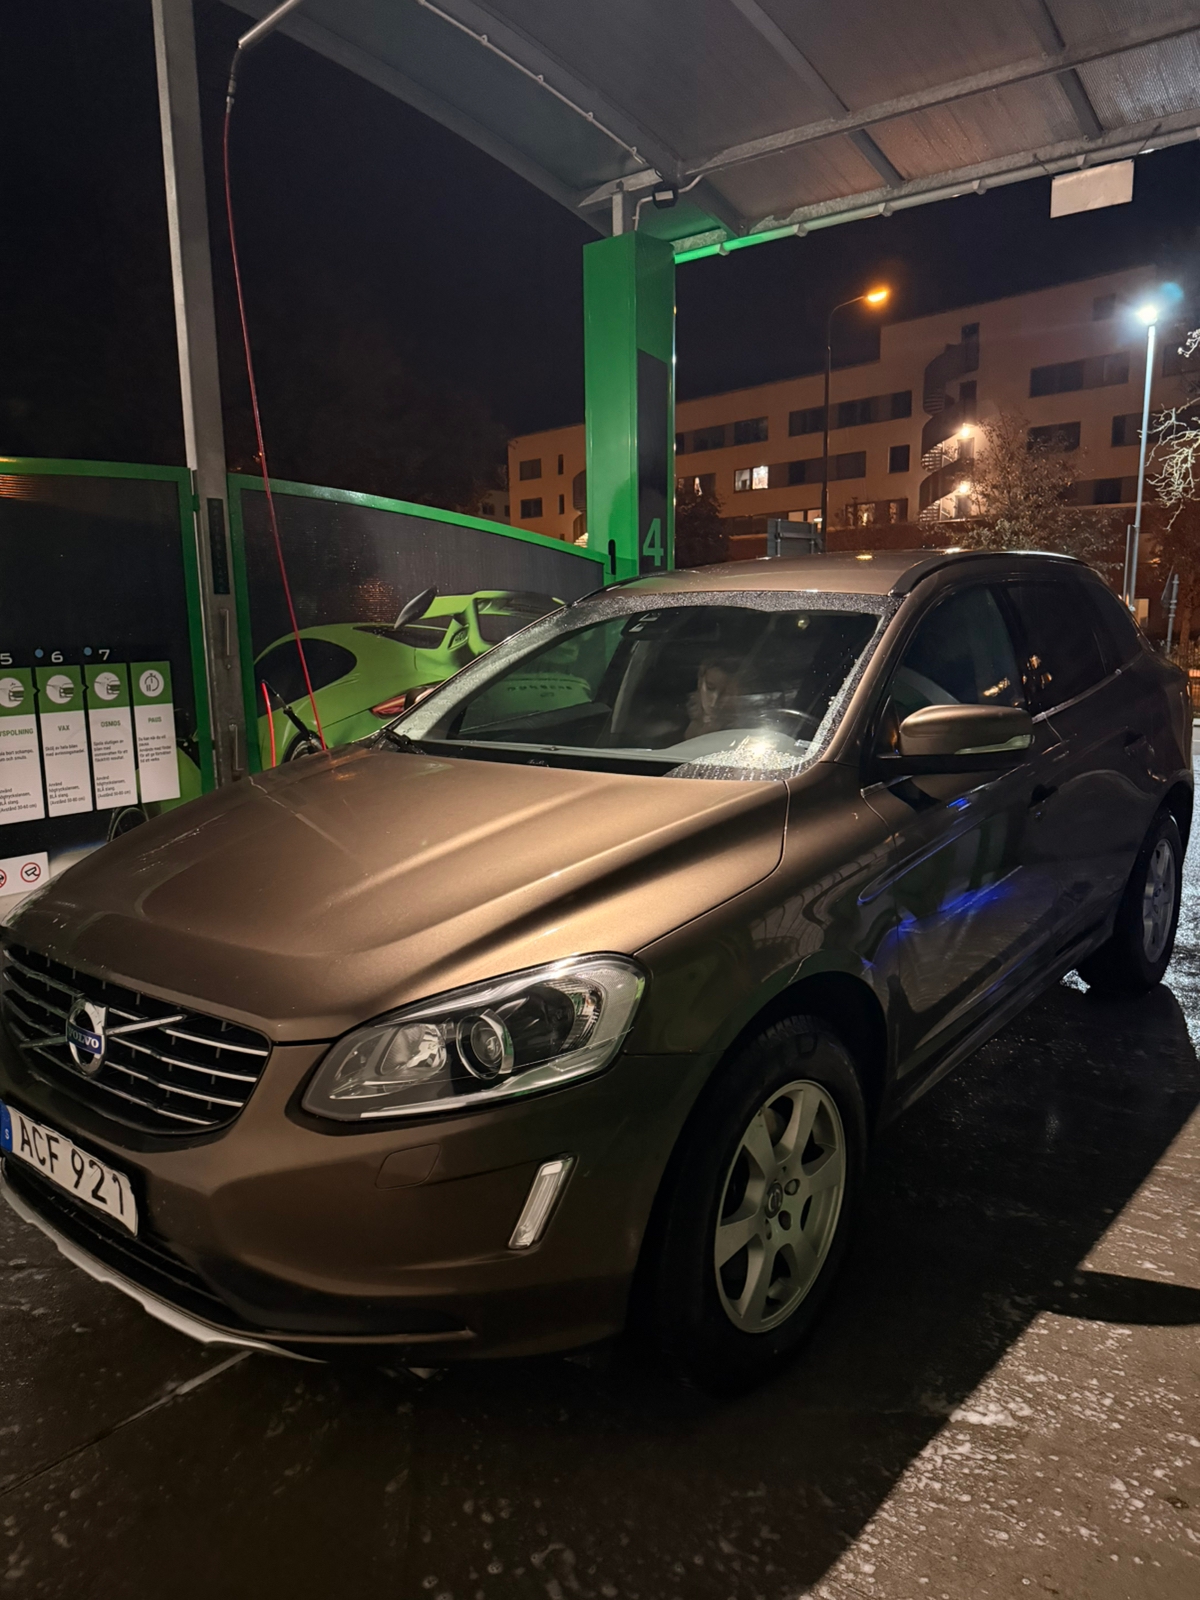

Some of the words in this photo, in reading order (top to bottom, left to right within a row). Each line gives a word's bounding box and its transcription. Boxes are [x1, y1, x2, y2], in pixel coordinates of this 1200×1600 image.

[642, 518, 664, 566] 4
[0, 653, 12, 665] 5
[51, 651, 64, 662] 6
[98, 649, 110, 660] 7
[68, 1028, 100, 1049] VOLVO
[19, 1116, 60, 1174] ACF
[71, 1148, 124, 1216] 921
